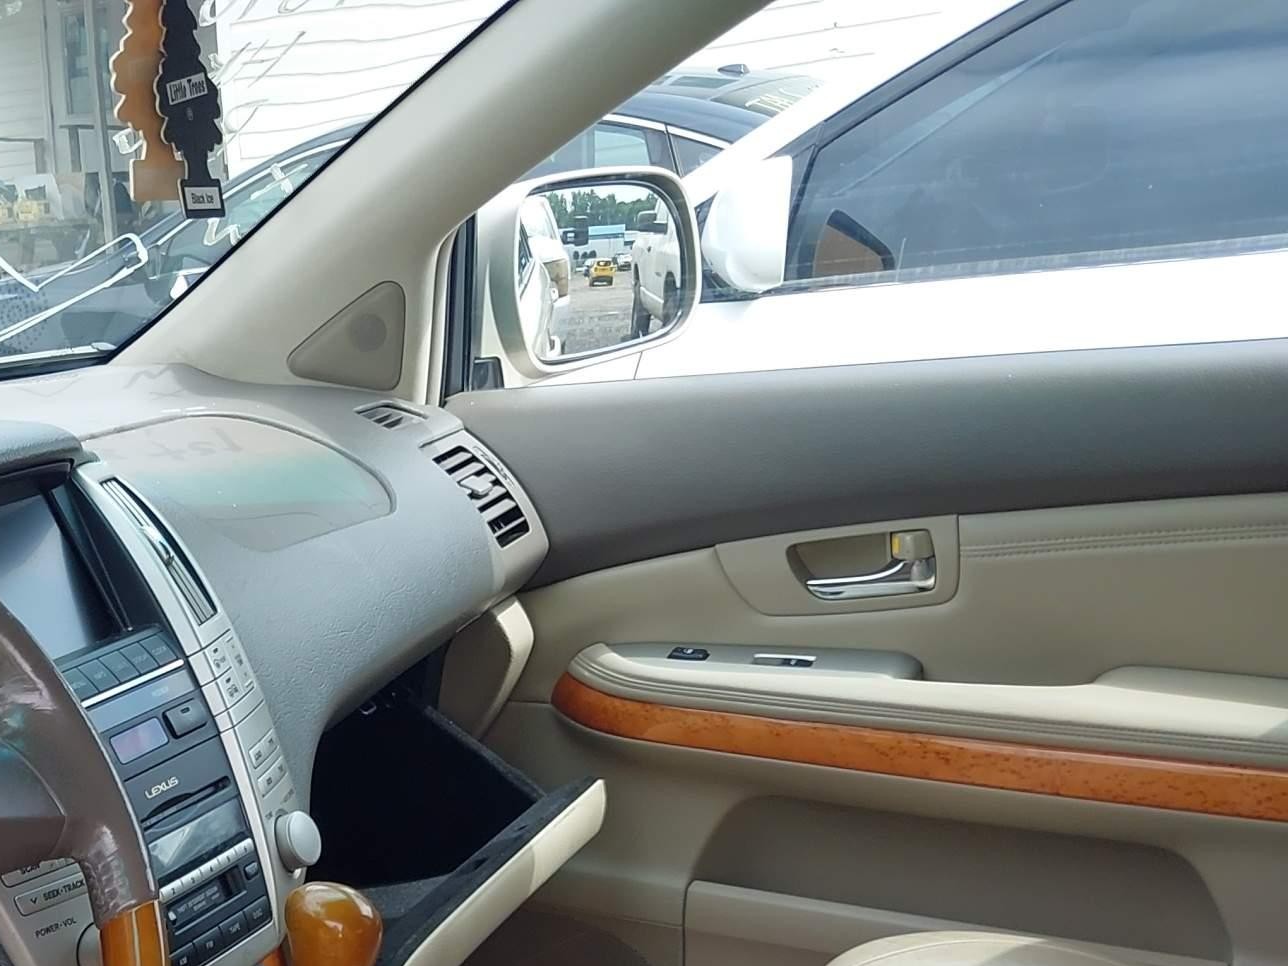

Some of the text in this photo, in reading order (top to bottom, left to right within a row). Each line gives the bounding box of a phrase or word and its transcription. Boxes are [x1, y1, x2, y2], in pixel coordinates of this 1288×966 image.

[169, 78, 206, 102] Little Trees
[191, 192, 214, 204] Black Ice
[144, 776, 179, 799] LEXUS
